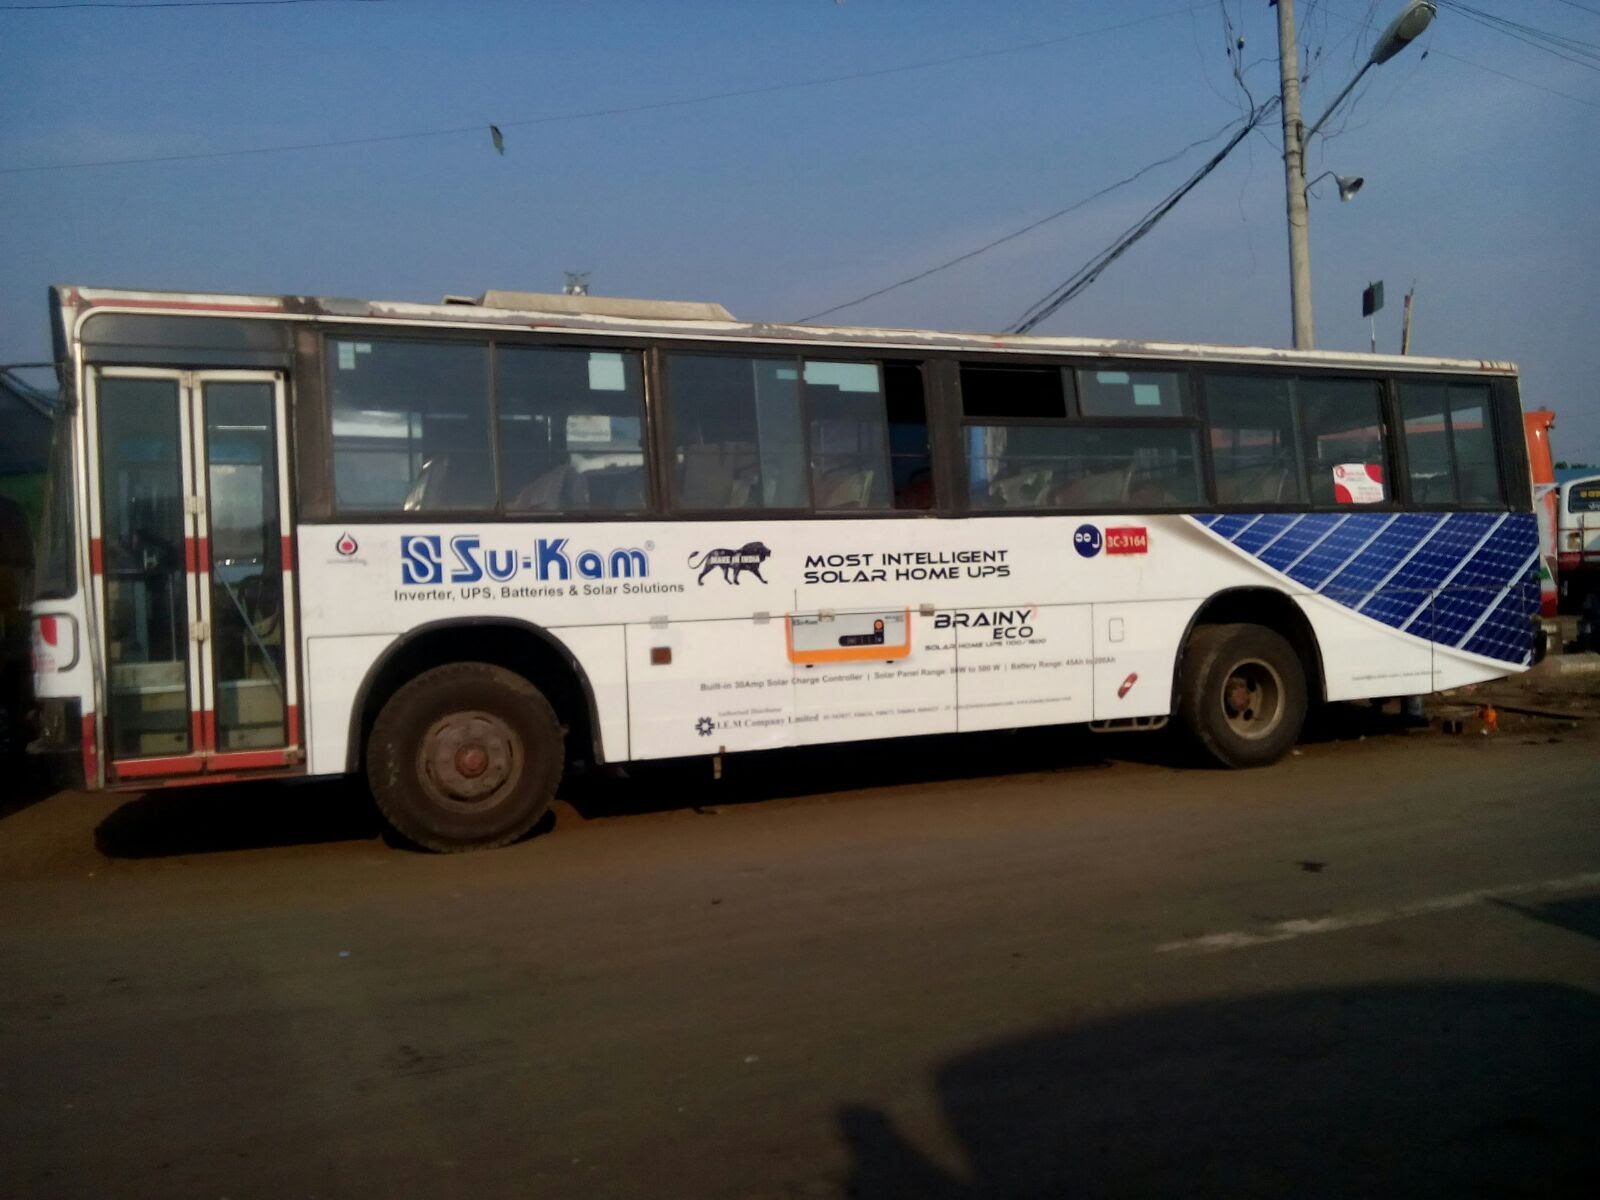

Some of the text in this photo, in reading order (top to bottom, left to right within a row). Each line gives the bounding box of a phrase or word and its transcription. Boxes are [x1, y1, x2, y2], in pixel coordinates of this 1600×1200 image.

[805, 550, 1008, 568] MOST INTELLIGENT
[804, 565, 1011, 584] SOLAR HOME UPS
[394, 582, 685, 602] Inverter, UPS, Batteries & Solar Solutions
[934, 609, 1032, 629] BRAINY
[993, 626, 1034, 640] ECO
[767, 678, 788, 687] Solar
[791, 676, 819, 685] Charge
[822, 672, 863, 682] Controller
[874, 670, 895, 679] Solar
[1011, 661, 1037, 671] Battery
[744, 718, 785, 728] Company
